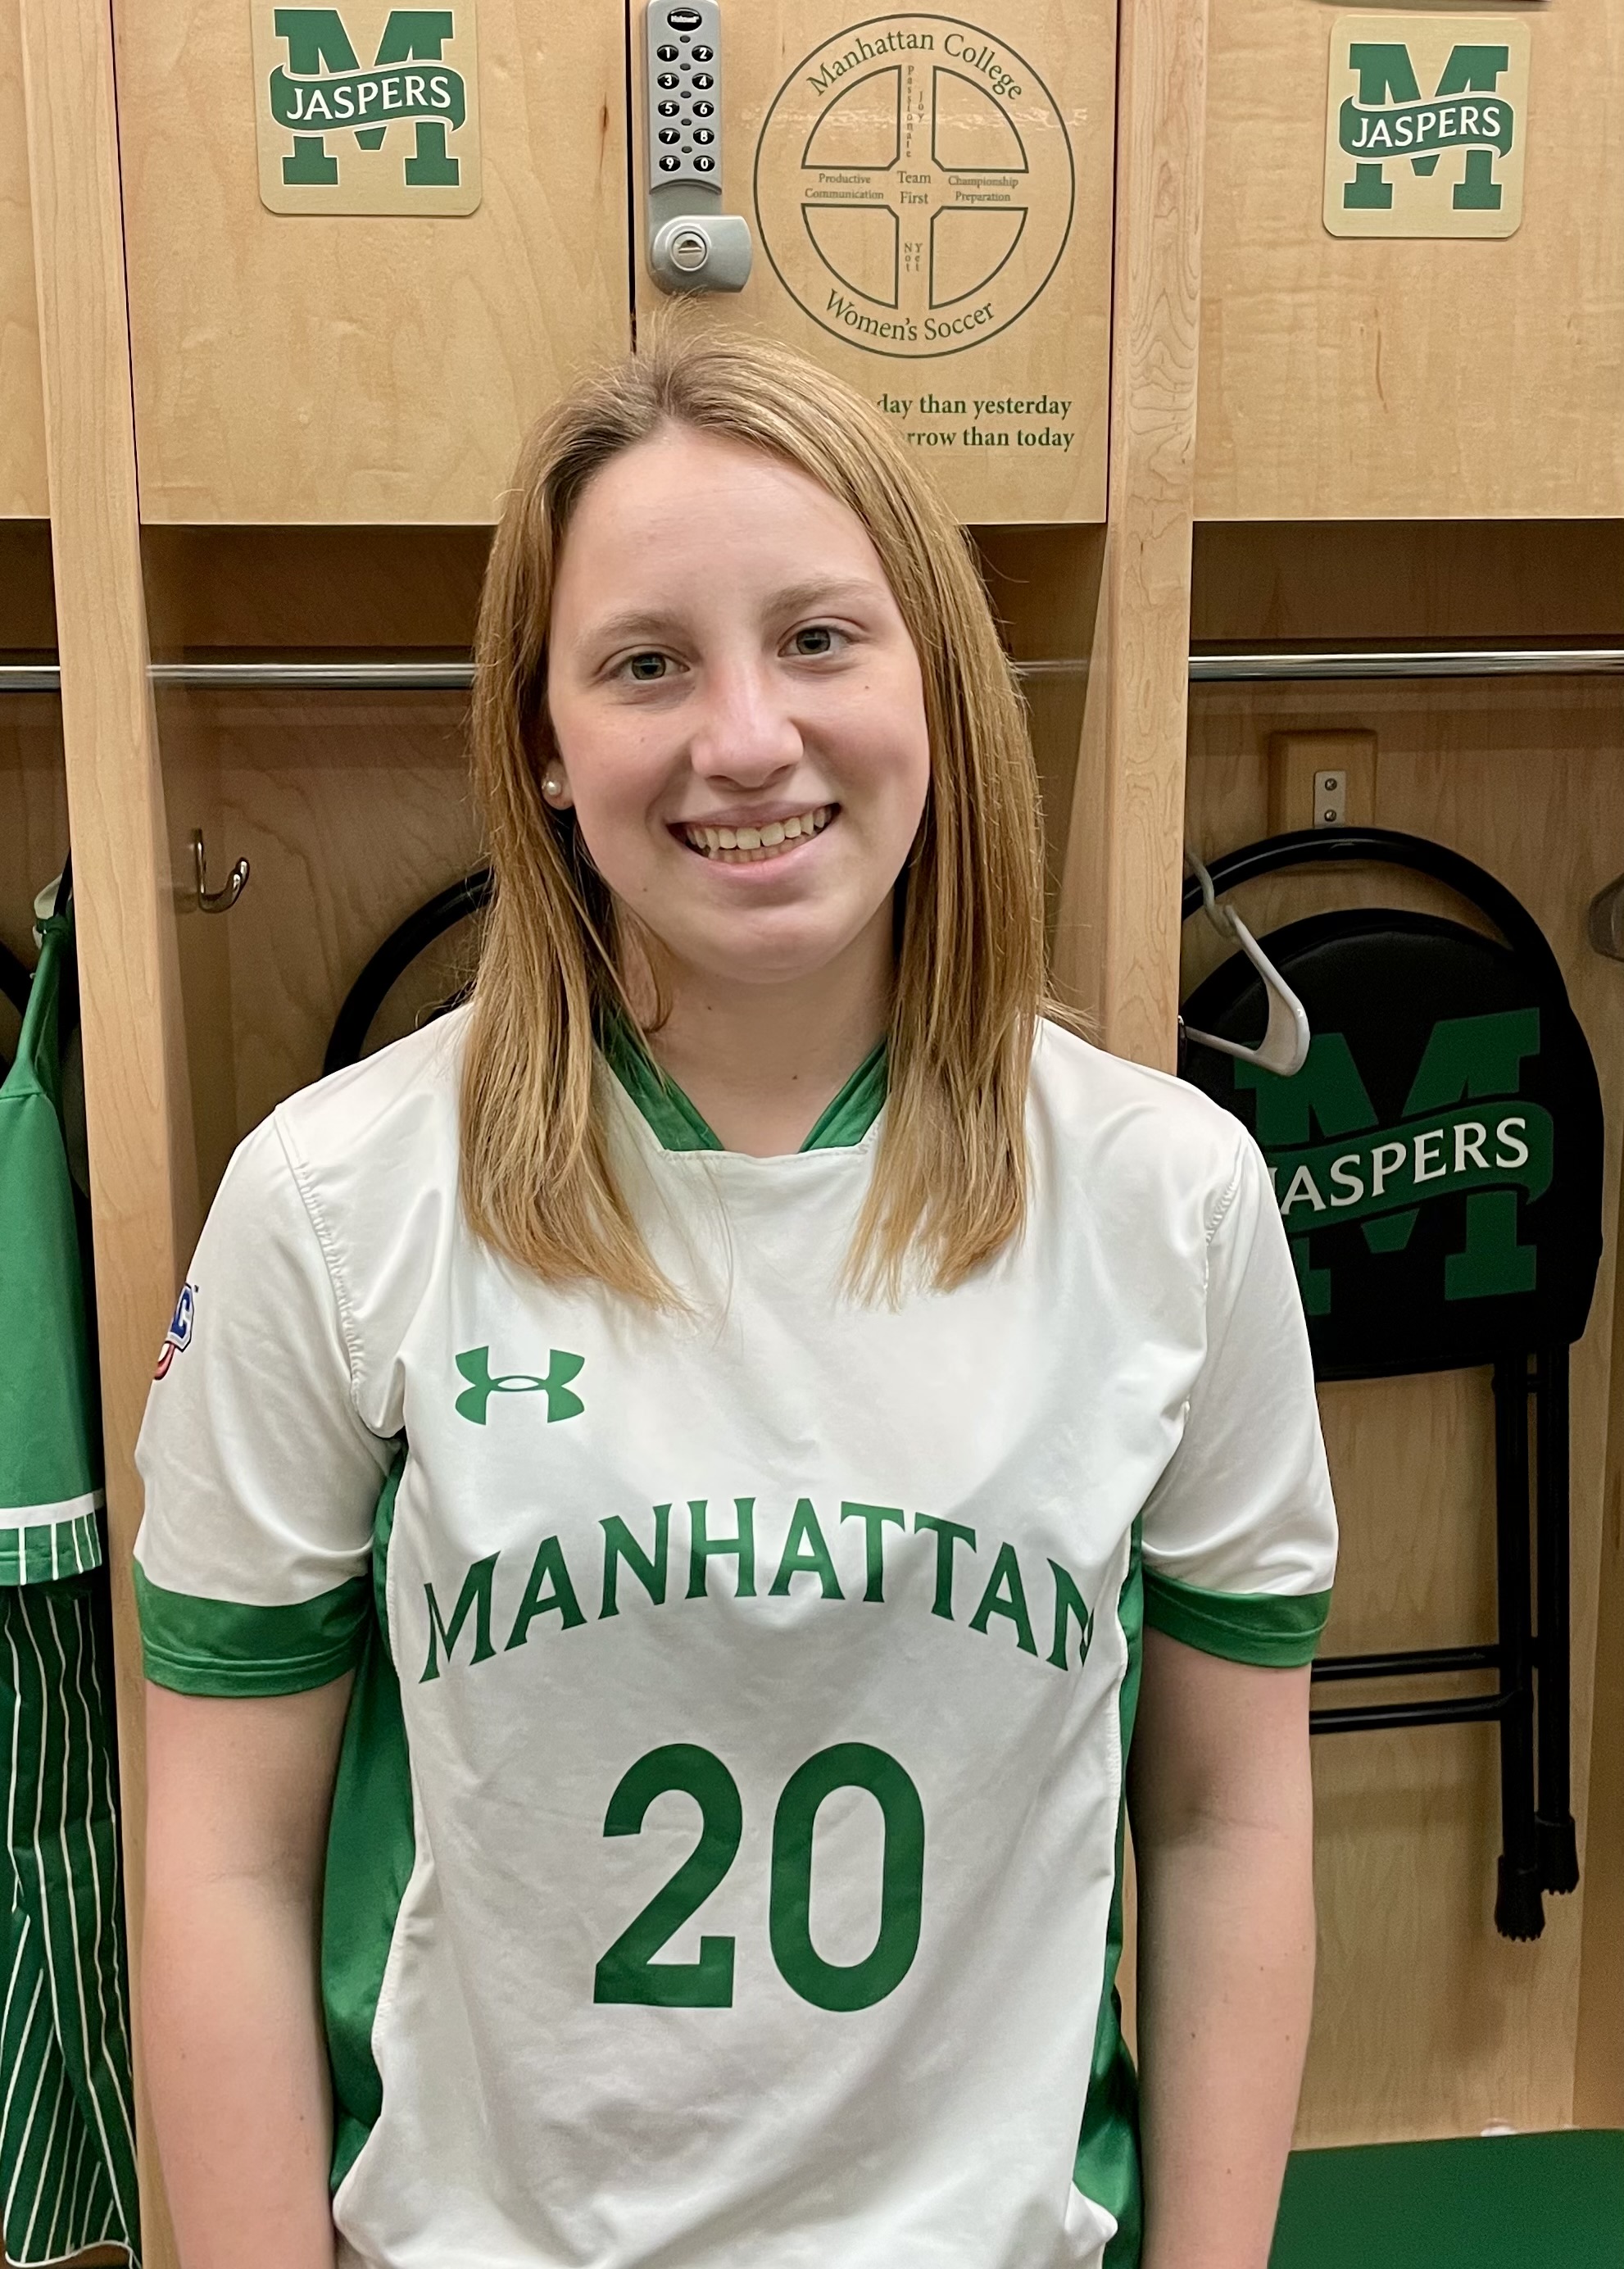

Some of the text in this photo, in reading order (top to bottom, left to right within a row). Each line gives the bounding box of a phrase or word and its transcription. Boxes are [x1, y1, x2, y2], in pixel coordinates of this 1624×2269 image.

[665, 48, 708, 59] 1 2
[806, 30, 1023, 100] Manhattan College
[665, 75, 707, 87] 3 4
[287, 75, 451, 120] JASPERS
[665, 102, 708, 114] 5 6
[1352, 107, 1501, 147] JASPERS
[665, 130, 708, 142] 7 8
[666, 157, 708, 169] 9 0
[819, 173, 871, 184] Productive
[896, 170, 932, 184] Team
[948, 175, 1019, 189] Championship
[805, 188, 884, 199] Communication
[900, 191, 928, 204] First
[955, 191, 1011, 203] Preparation
[825, 288, 995, 341] Women's Soccer
[919, 393, 967, 414] than
[973, 395, 1072, 420] yesterday
[963, 426, 1009, 447] than
[1017, 427, 1075, 452] today
[419, 1497, 1095, 1684] MANHATTAN
[593, 1742, 925, 2013] 20
